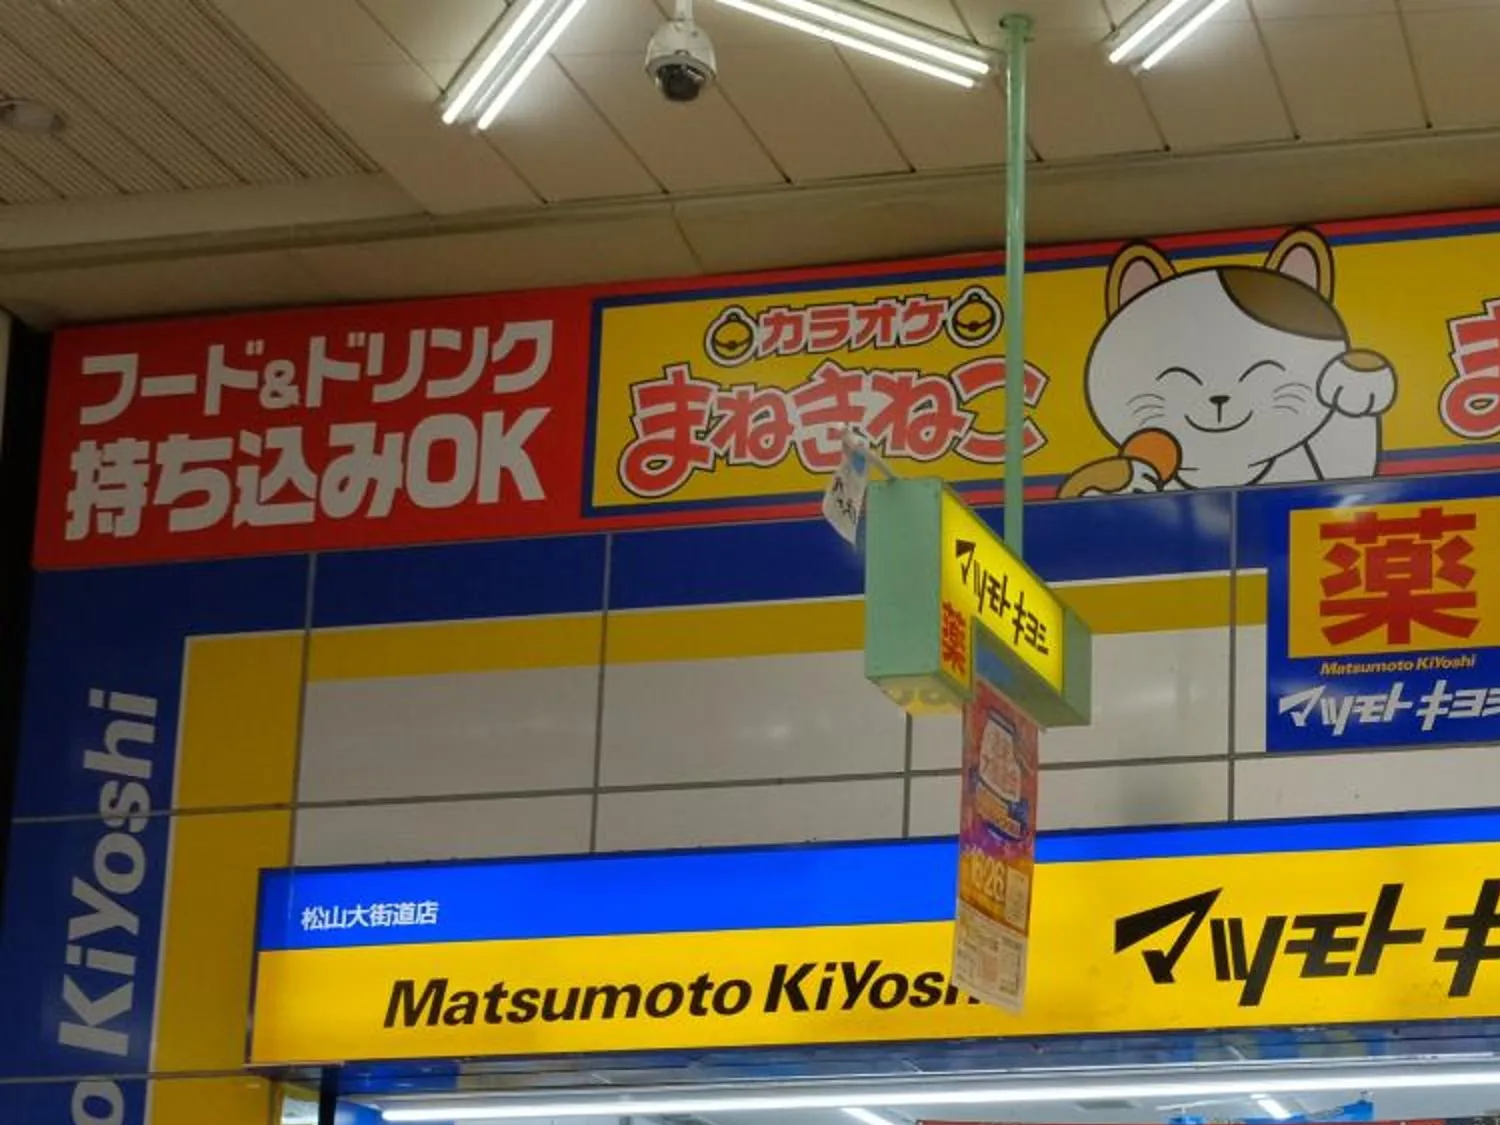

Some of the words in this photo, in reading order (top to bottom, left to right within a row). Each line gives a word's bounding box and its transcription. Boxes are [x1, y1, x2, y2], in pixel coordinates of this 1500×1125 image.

[79, 319, 554, 426] フード&ドリンク
[755, 292, 953, 358] カラオケ
[65, 406, 551, 541] 持ち込みOK
[618, 356, 1050, 497] まねきねこ
[953, 539, 1050, 656] マツモトキヨシ
[1319, 507, 1479, 646] 薬
[941, 601, 968, 676] 薬
[1320, 657, 1414, 676] Matsumoto
[1416, 653, 1476, 671] KiYoshi
[57, 689, 158, 1057] KiYoshi
[300, 900, 439, 931] 松山大街道店
[383, 977, 752, 1029] Matsumoto
[762, 959, 983, 1012] KiYos
